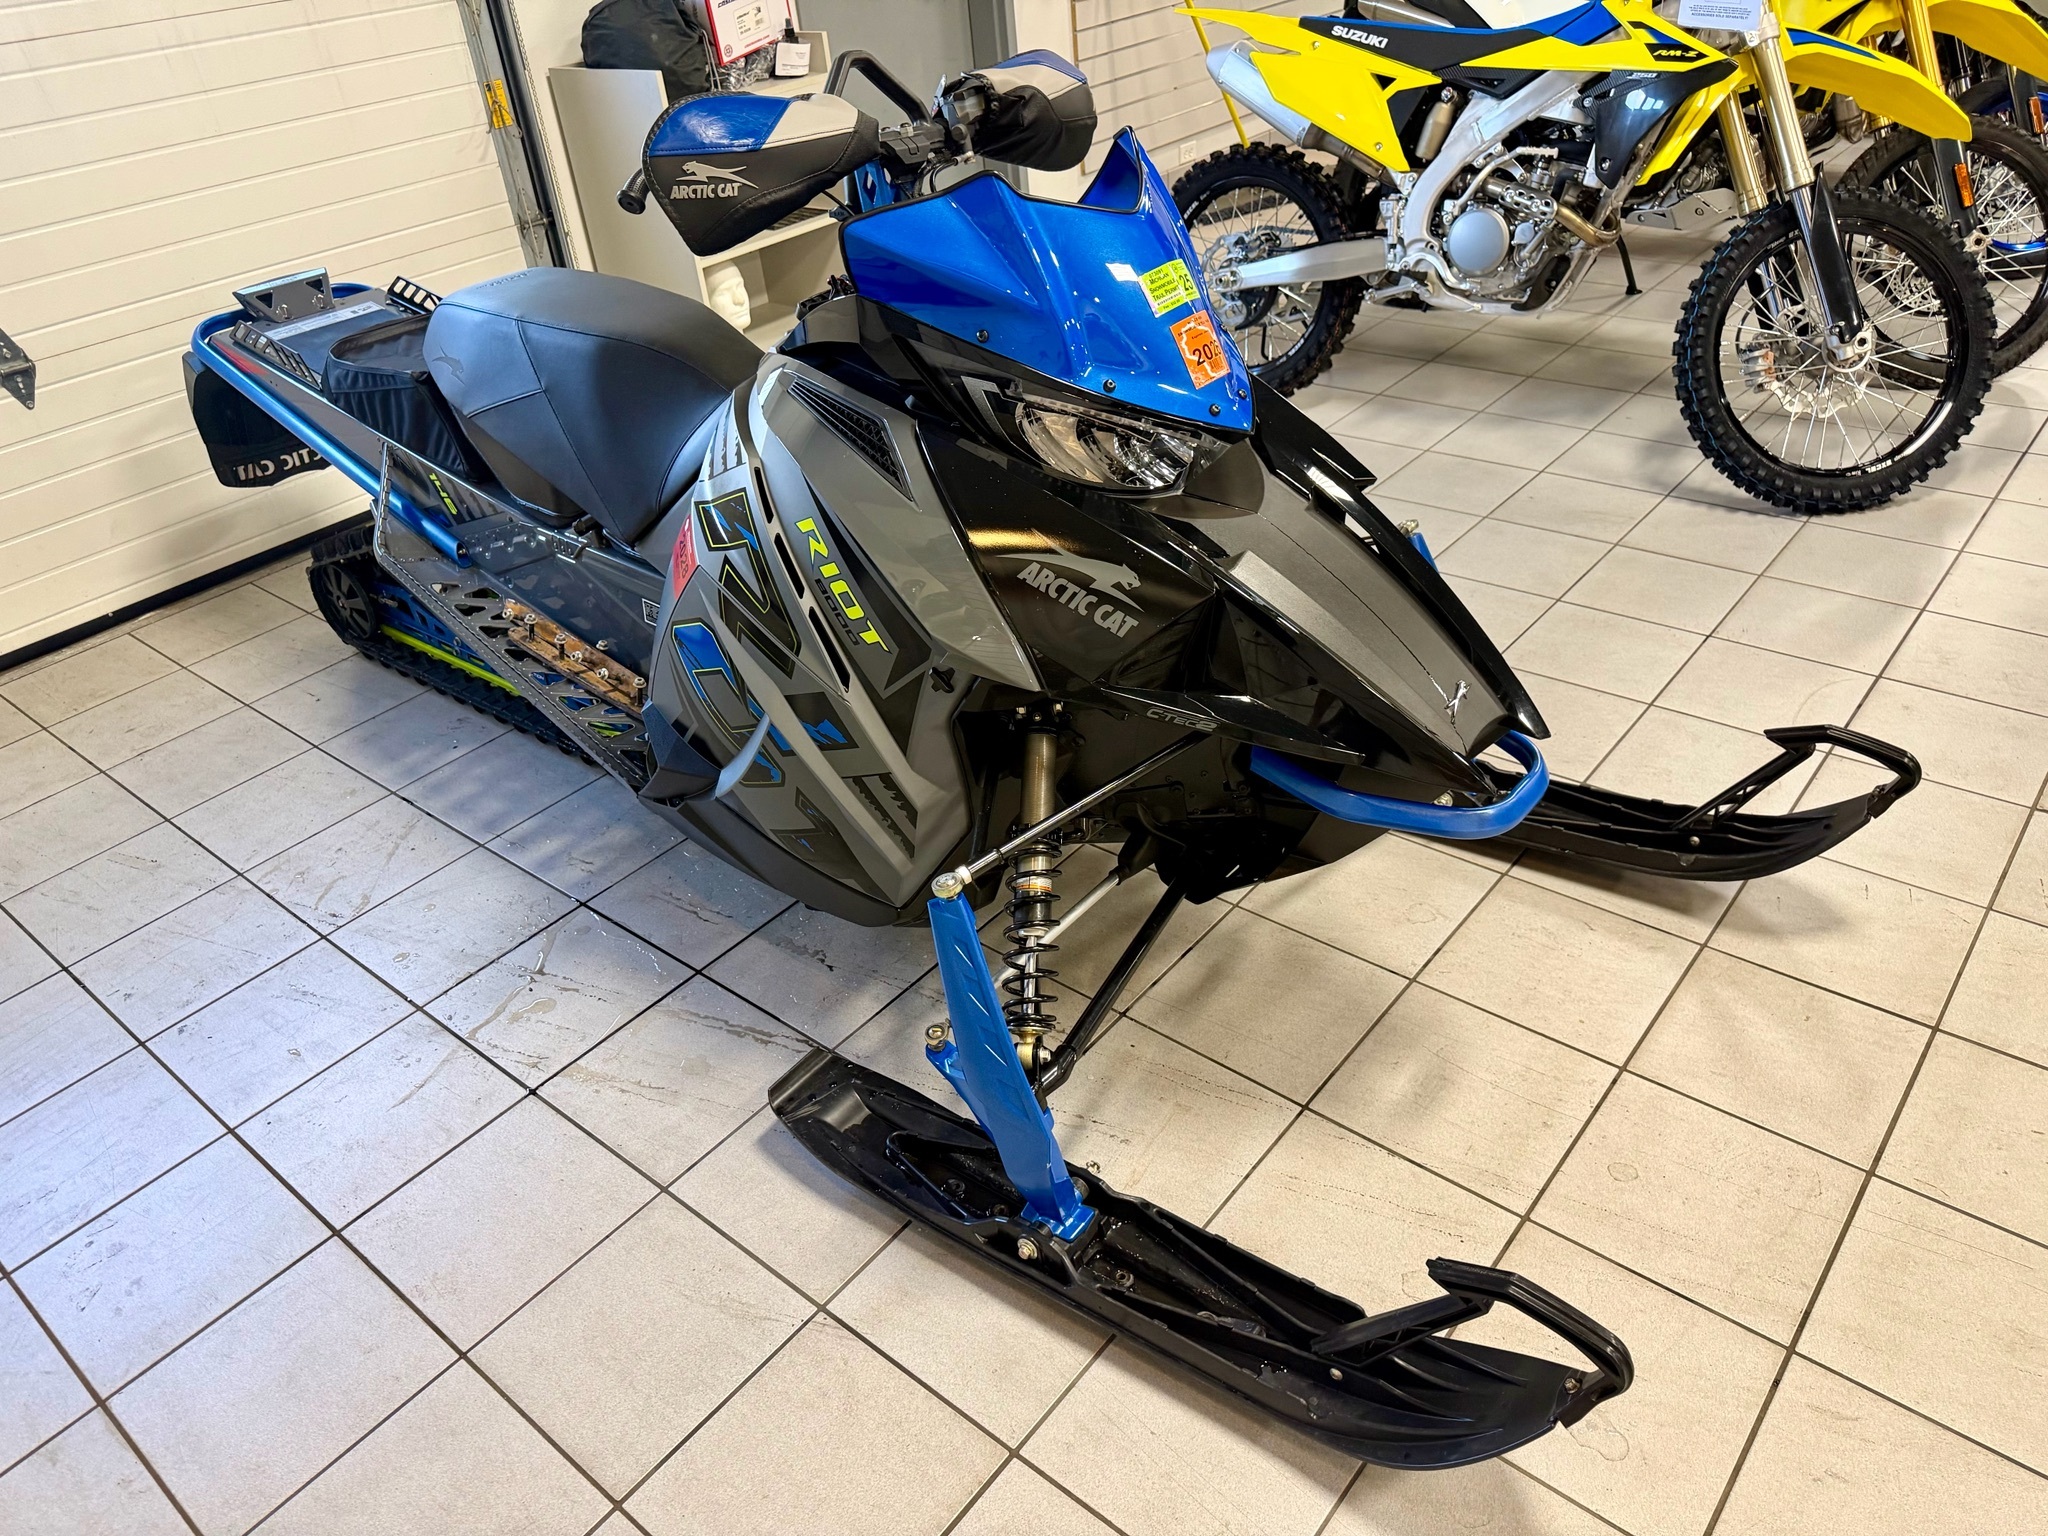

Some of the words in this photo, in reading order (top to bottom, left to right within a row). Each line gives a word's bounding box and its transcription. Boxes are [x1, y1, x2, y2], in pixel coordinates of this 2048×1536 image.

[1331, 25, 1389, 49] SUZUKI
[1653, 49, 1699, 58] RM-Z
[670, 184, 715, 200] ARCTIC
[717, 182, 742, 198] CAT
[1178, 273, 1194, 292] 25
[429, 472, 458, 515] 146
[795, 516, 891, 654] RIOT
[1016, 561, 1099, 617] ARCTIC
[1093, 604, 1140, 638] CAT
[814, 578, 860, 646] 8000
[1146, 708, 1218, 732] C-TEC2
